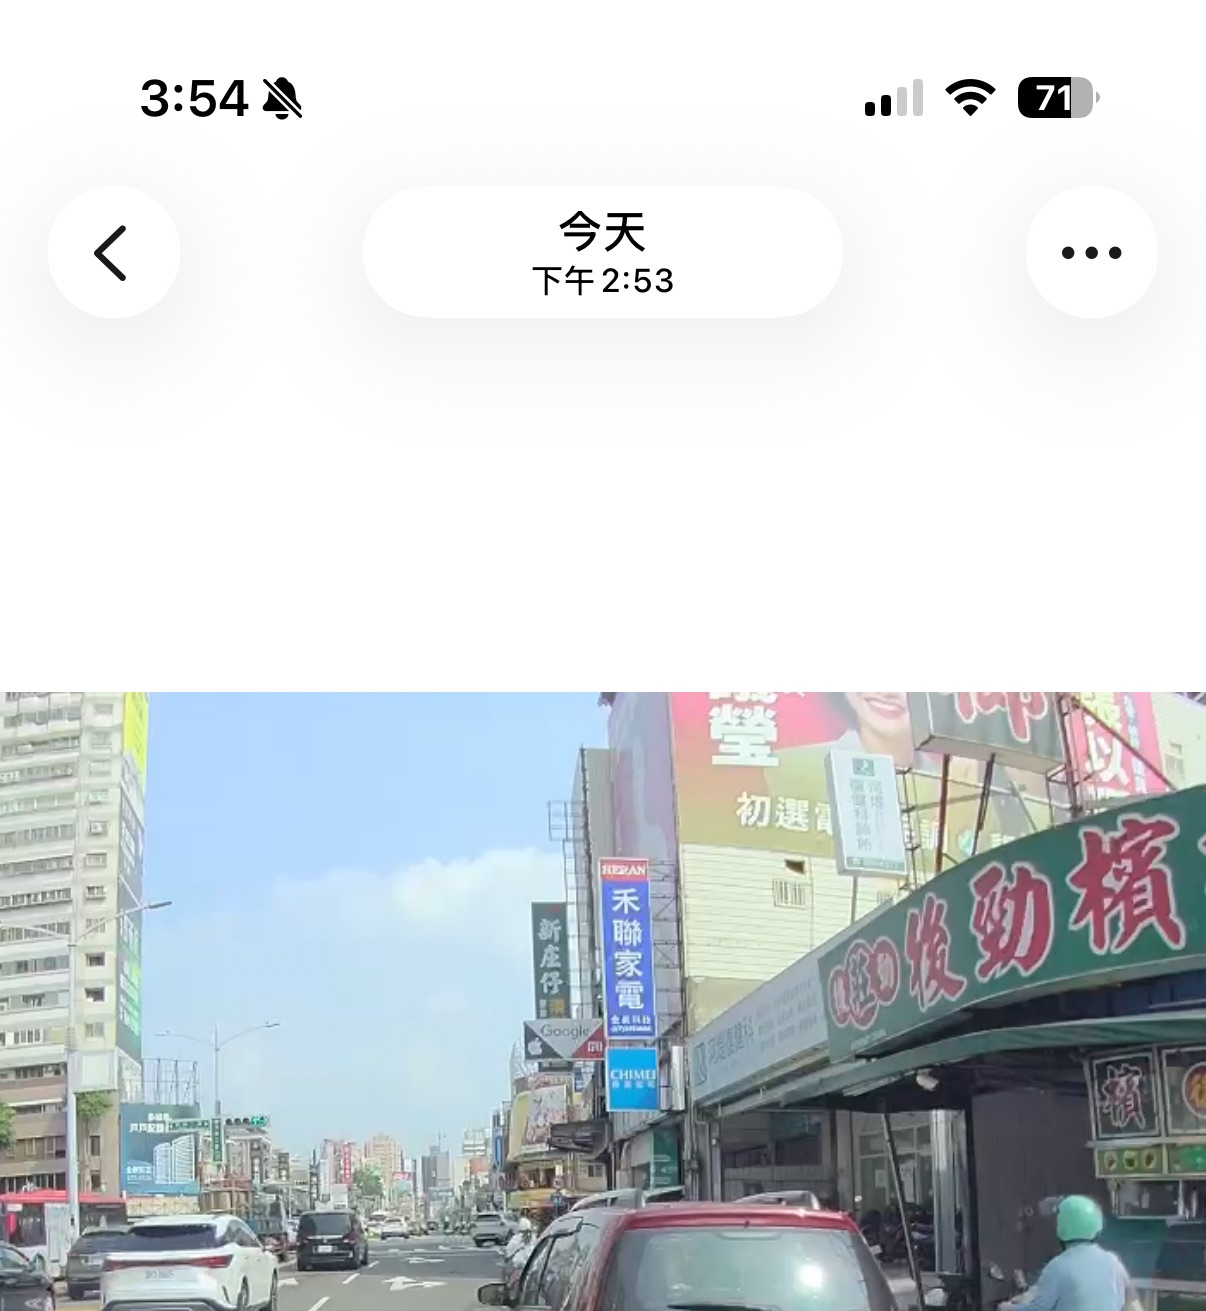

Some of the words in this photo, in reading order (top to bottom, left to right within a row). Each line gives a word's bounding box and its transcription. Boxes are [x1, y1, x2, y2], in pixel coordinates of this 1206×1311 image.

[708, 692, 779, 766] 瑩
[602, 865, 646, 875] HERAN
[612, 888, 644, 1009] 禾聯家電
[904, 813, 1206, 1013] 後勁檳
[537, 918, 563, 994] 新庄仔
[540, 1024, 590, 1039] Google
[610, 1069, 656, 1081] CHIMEI
